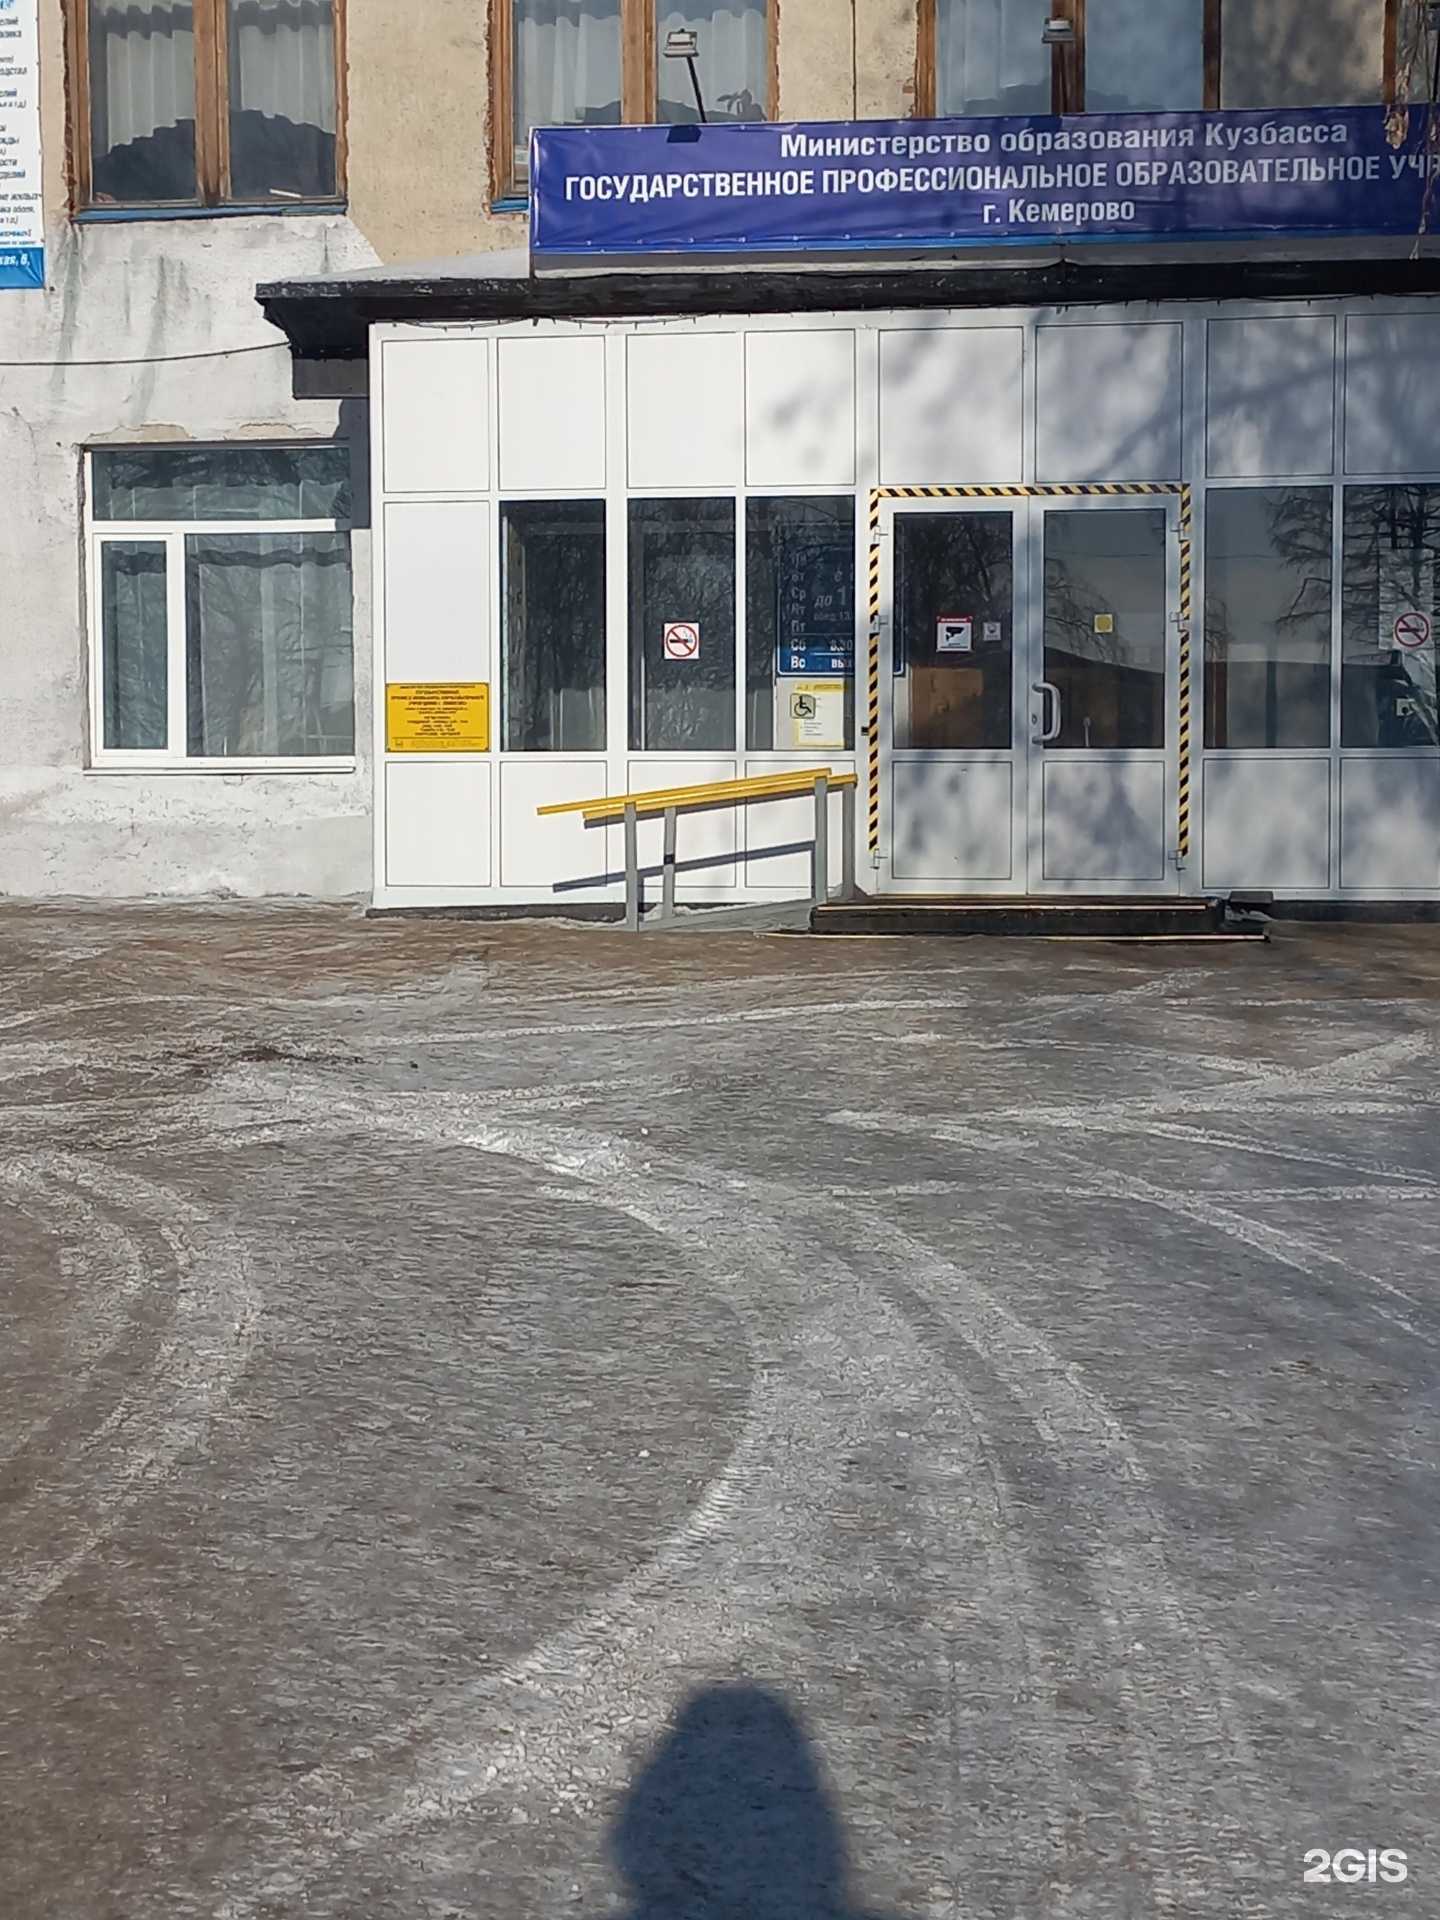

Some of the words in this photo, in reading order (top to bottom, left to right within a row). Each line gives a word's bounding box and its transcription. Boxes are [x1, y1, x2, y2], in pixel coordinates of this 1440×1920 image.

[780, 133, 990, 160] Министерство
[1000, 126, 1195, 155] образования
[1205, 122, 1347, 151] Кузбасса
[565, 170, 814, 202] ГОСУДАРСТВЕННОЕ
[822, 162, 1106, 195] ПРОФЕССИОНАЛЬНОЕ
[1116, 155, 1380, 187] ОБРАЗОВАТЕЛЬНОЕ
[983, 204, 1000, 224] г.
[1008, 199, 1135, 226] Кемерово
[791, 655, 806, 669] Вс
